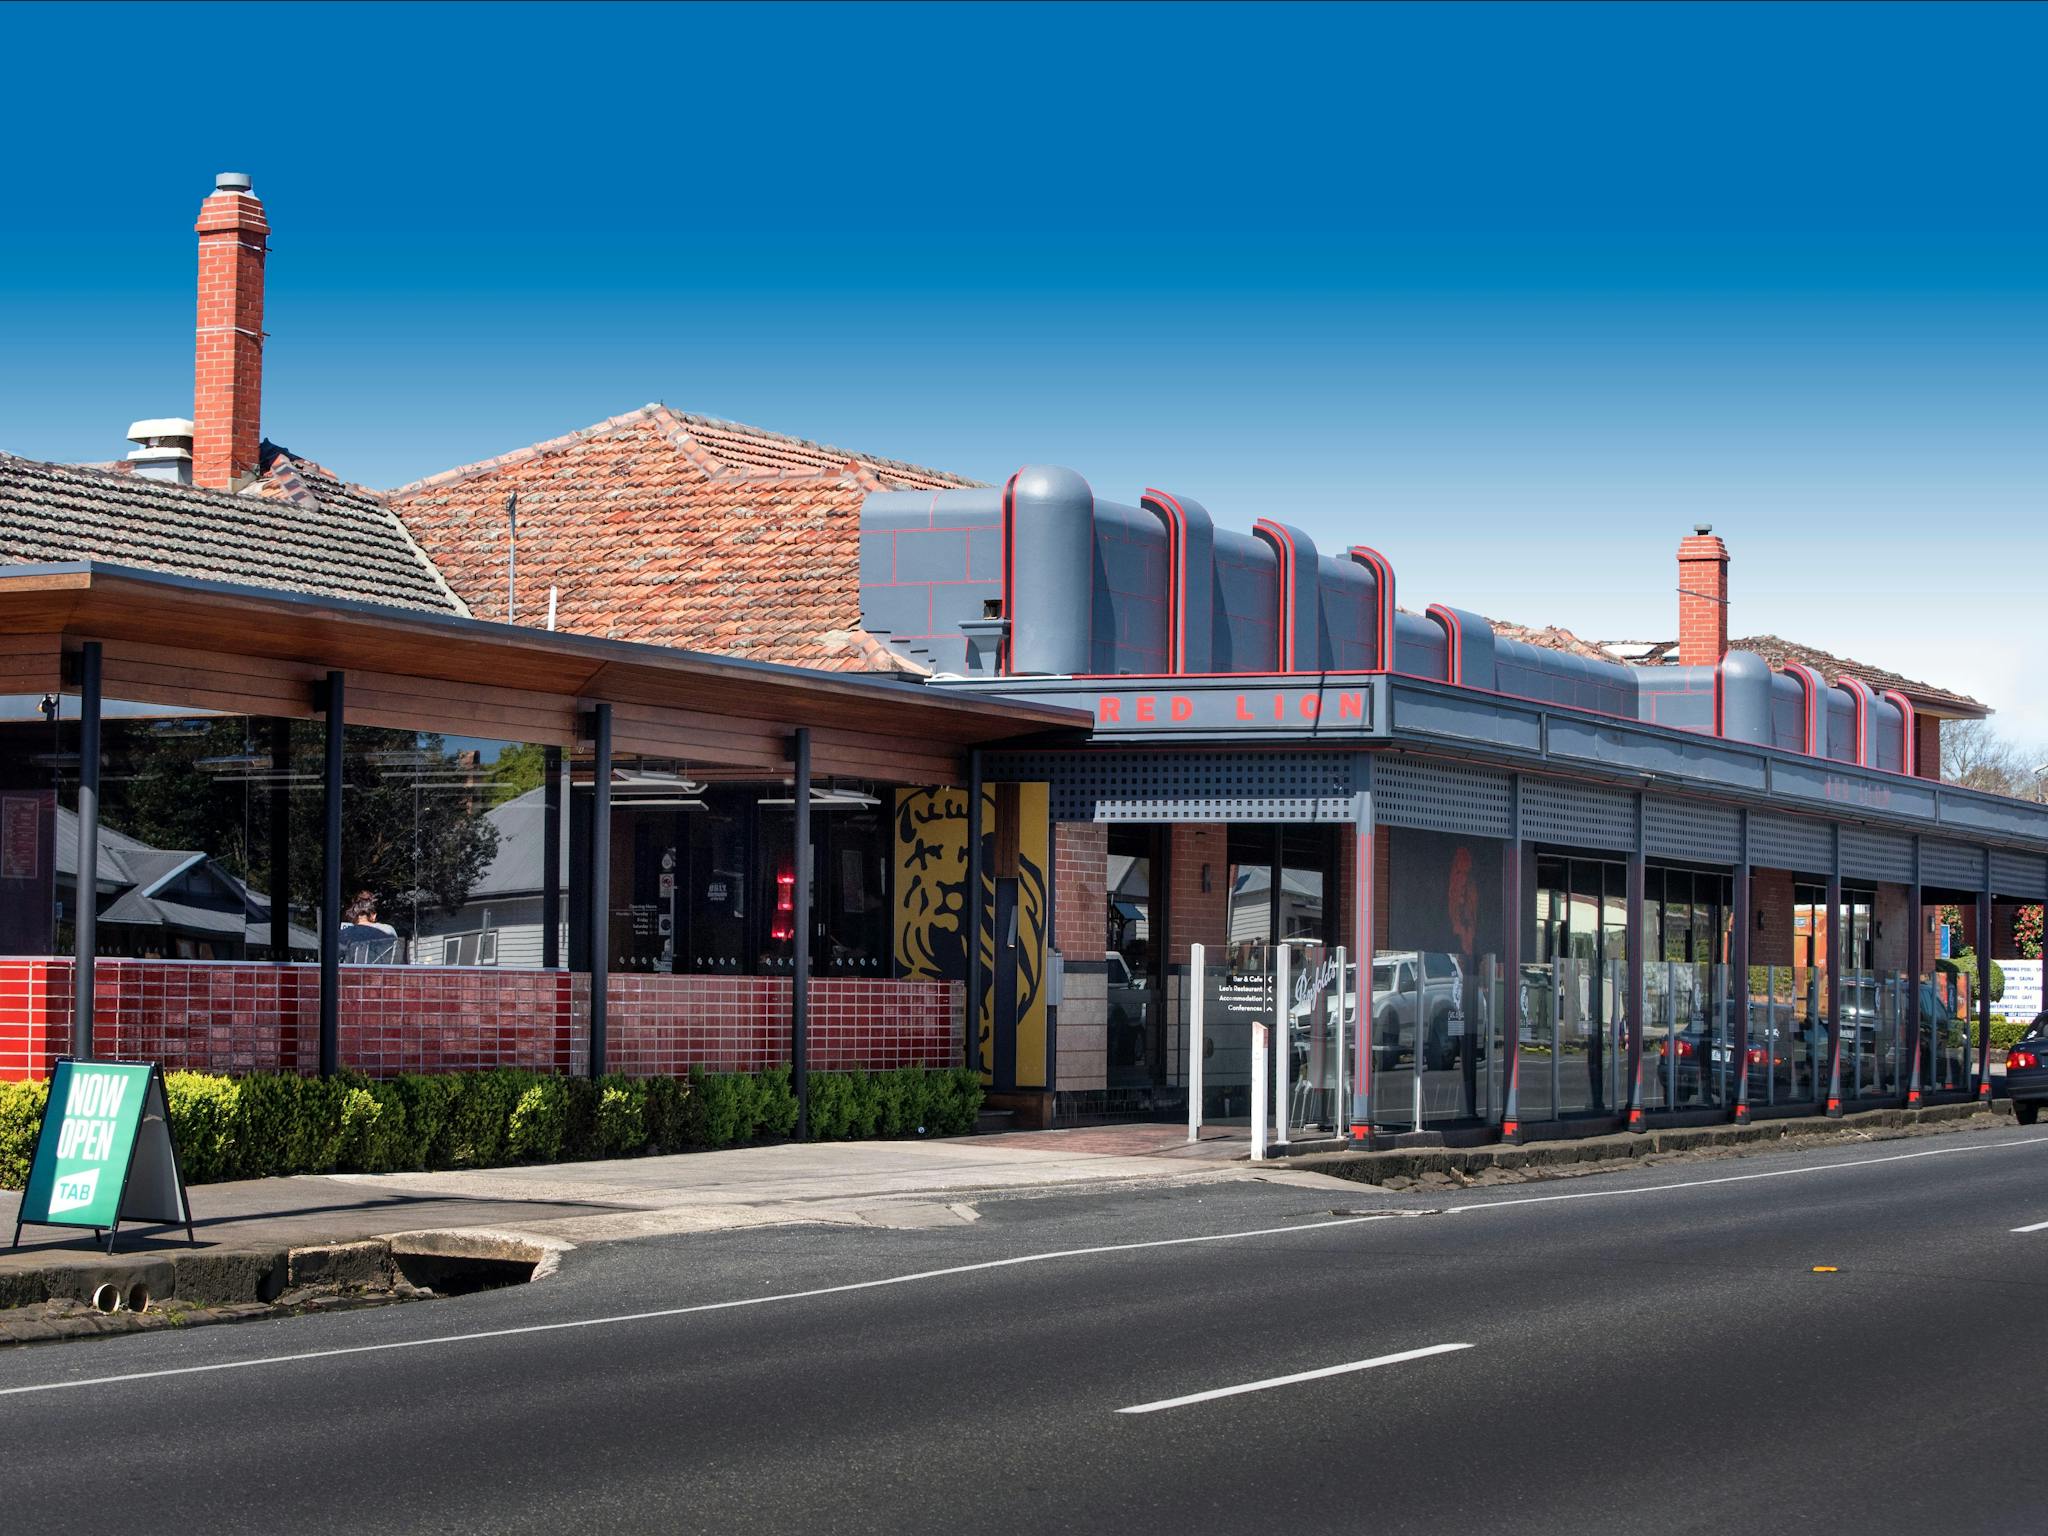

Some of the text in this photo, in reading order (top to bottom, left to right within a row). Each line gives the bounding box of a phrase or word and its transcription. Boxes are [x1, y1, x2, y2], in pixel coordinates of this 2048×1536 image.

[1100, 692, 1363, 723] RED LION
[65, 1072, 129, 1118] NOW
[56, 1117, 117, 1161] OPEN
[60, 1182, 90, 1200] TAB
